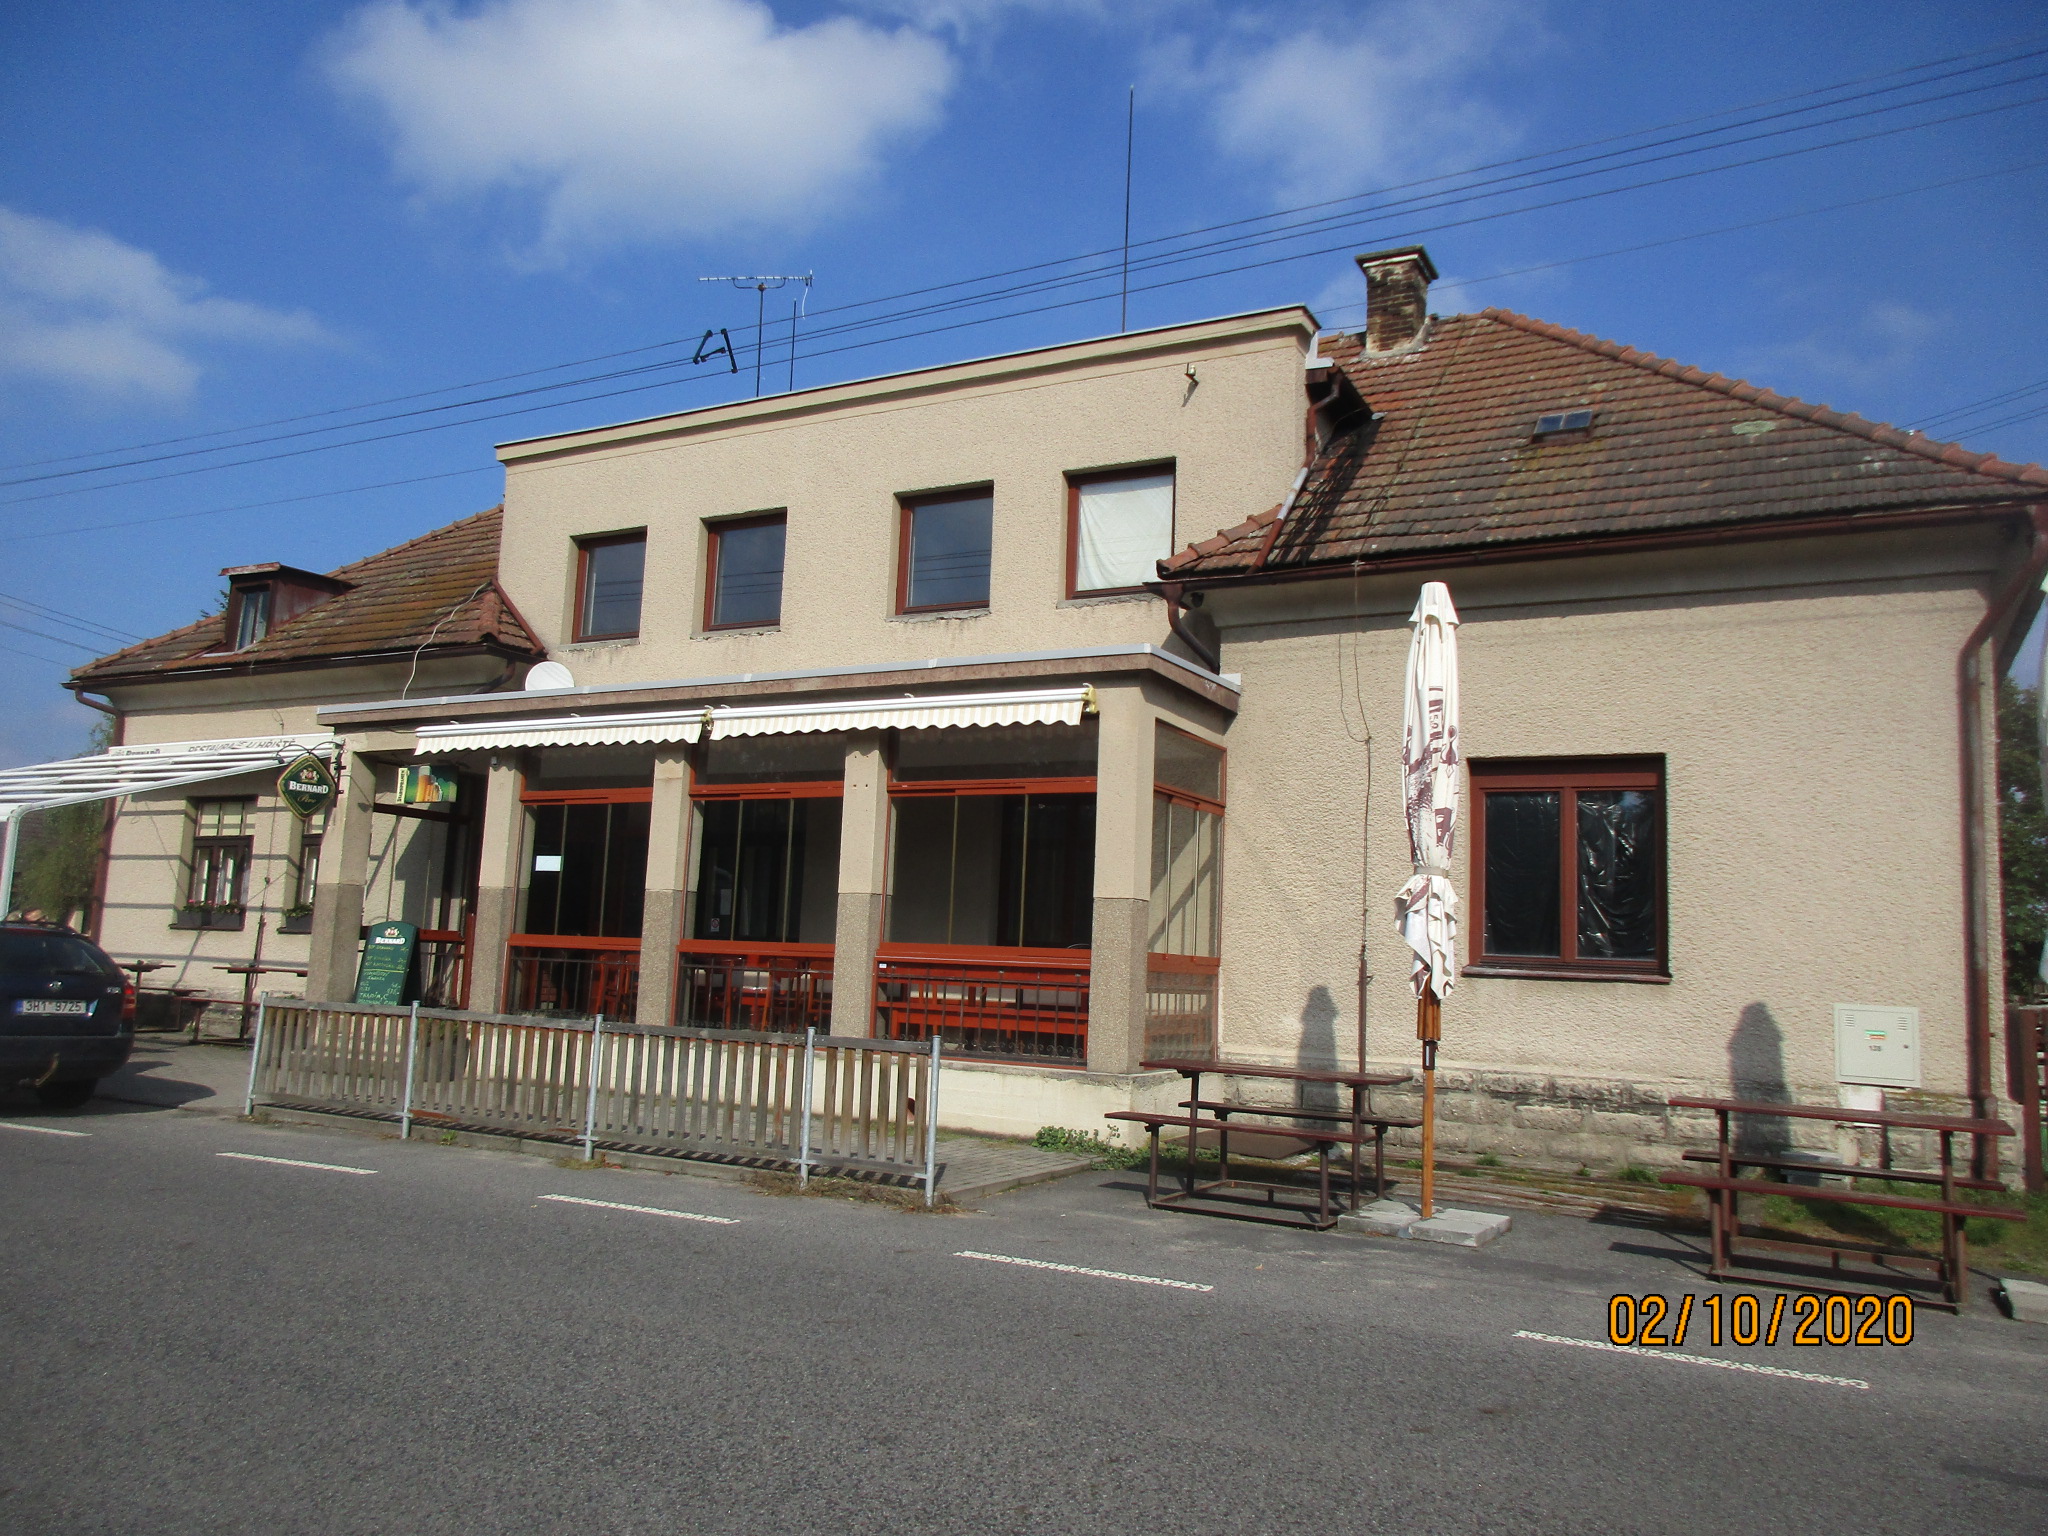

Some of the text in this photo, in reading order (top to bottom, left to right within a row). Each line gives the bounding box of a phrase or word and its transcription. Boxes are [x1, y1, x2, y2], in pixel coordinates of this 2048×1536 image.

[289, 780, 329, 794] BERNARD
[375, 937, 406, 945] BERNARD
[26, 1001, 82, 1012] 3H1 9725
